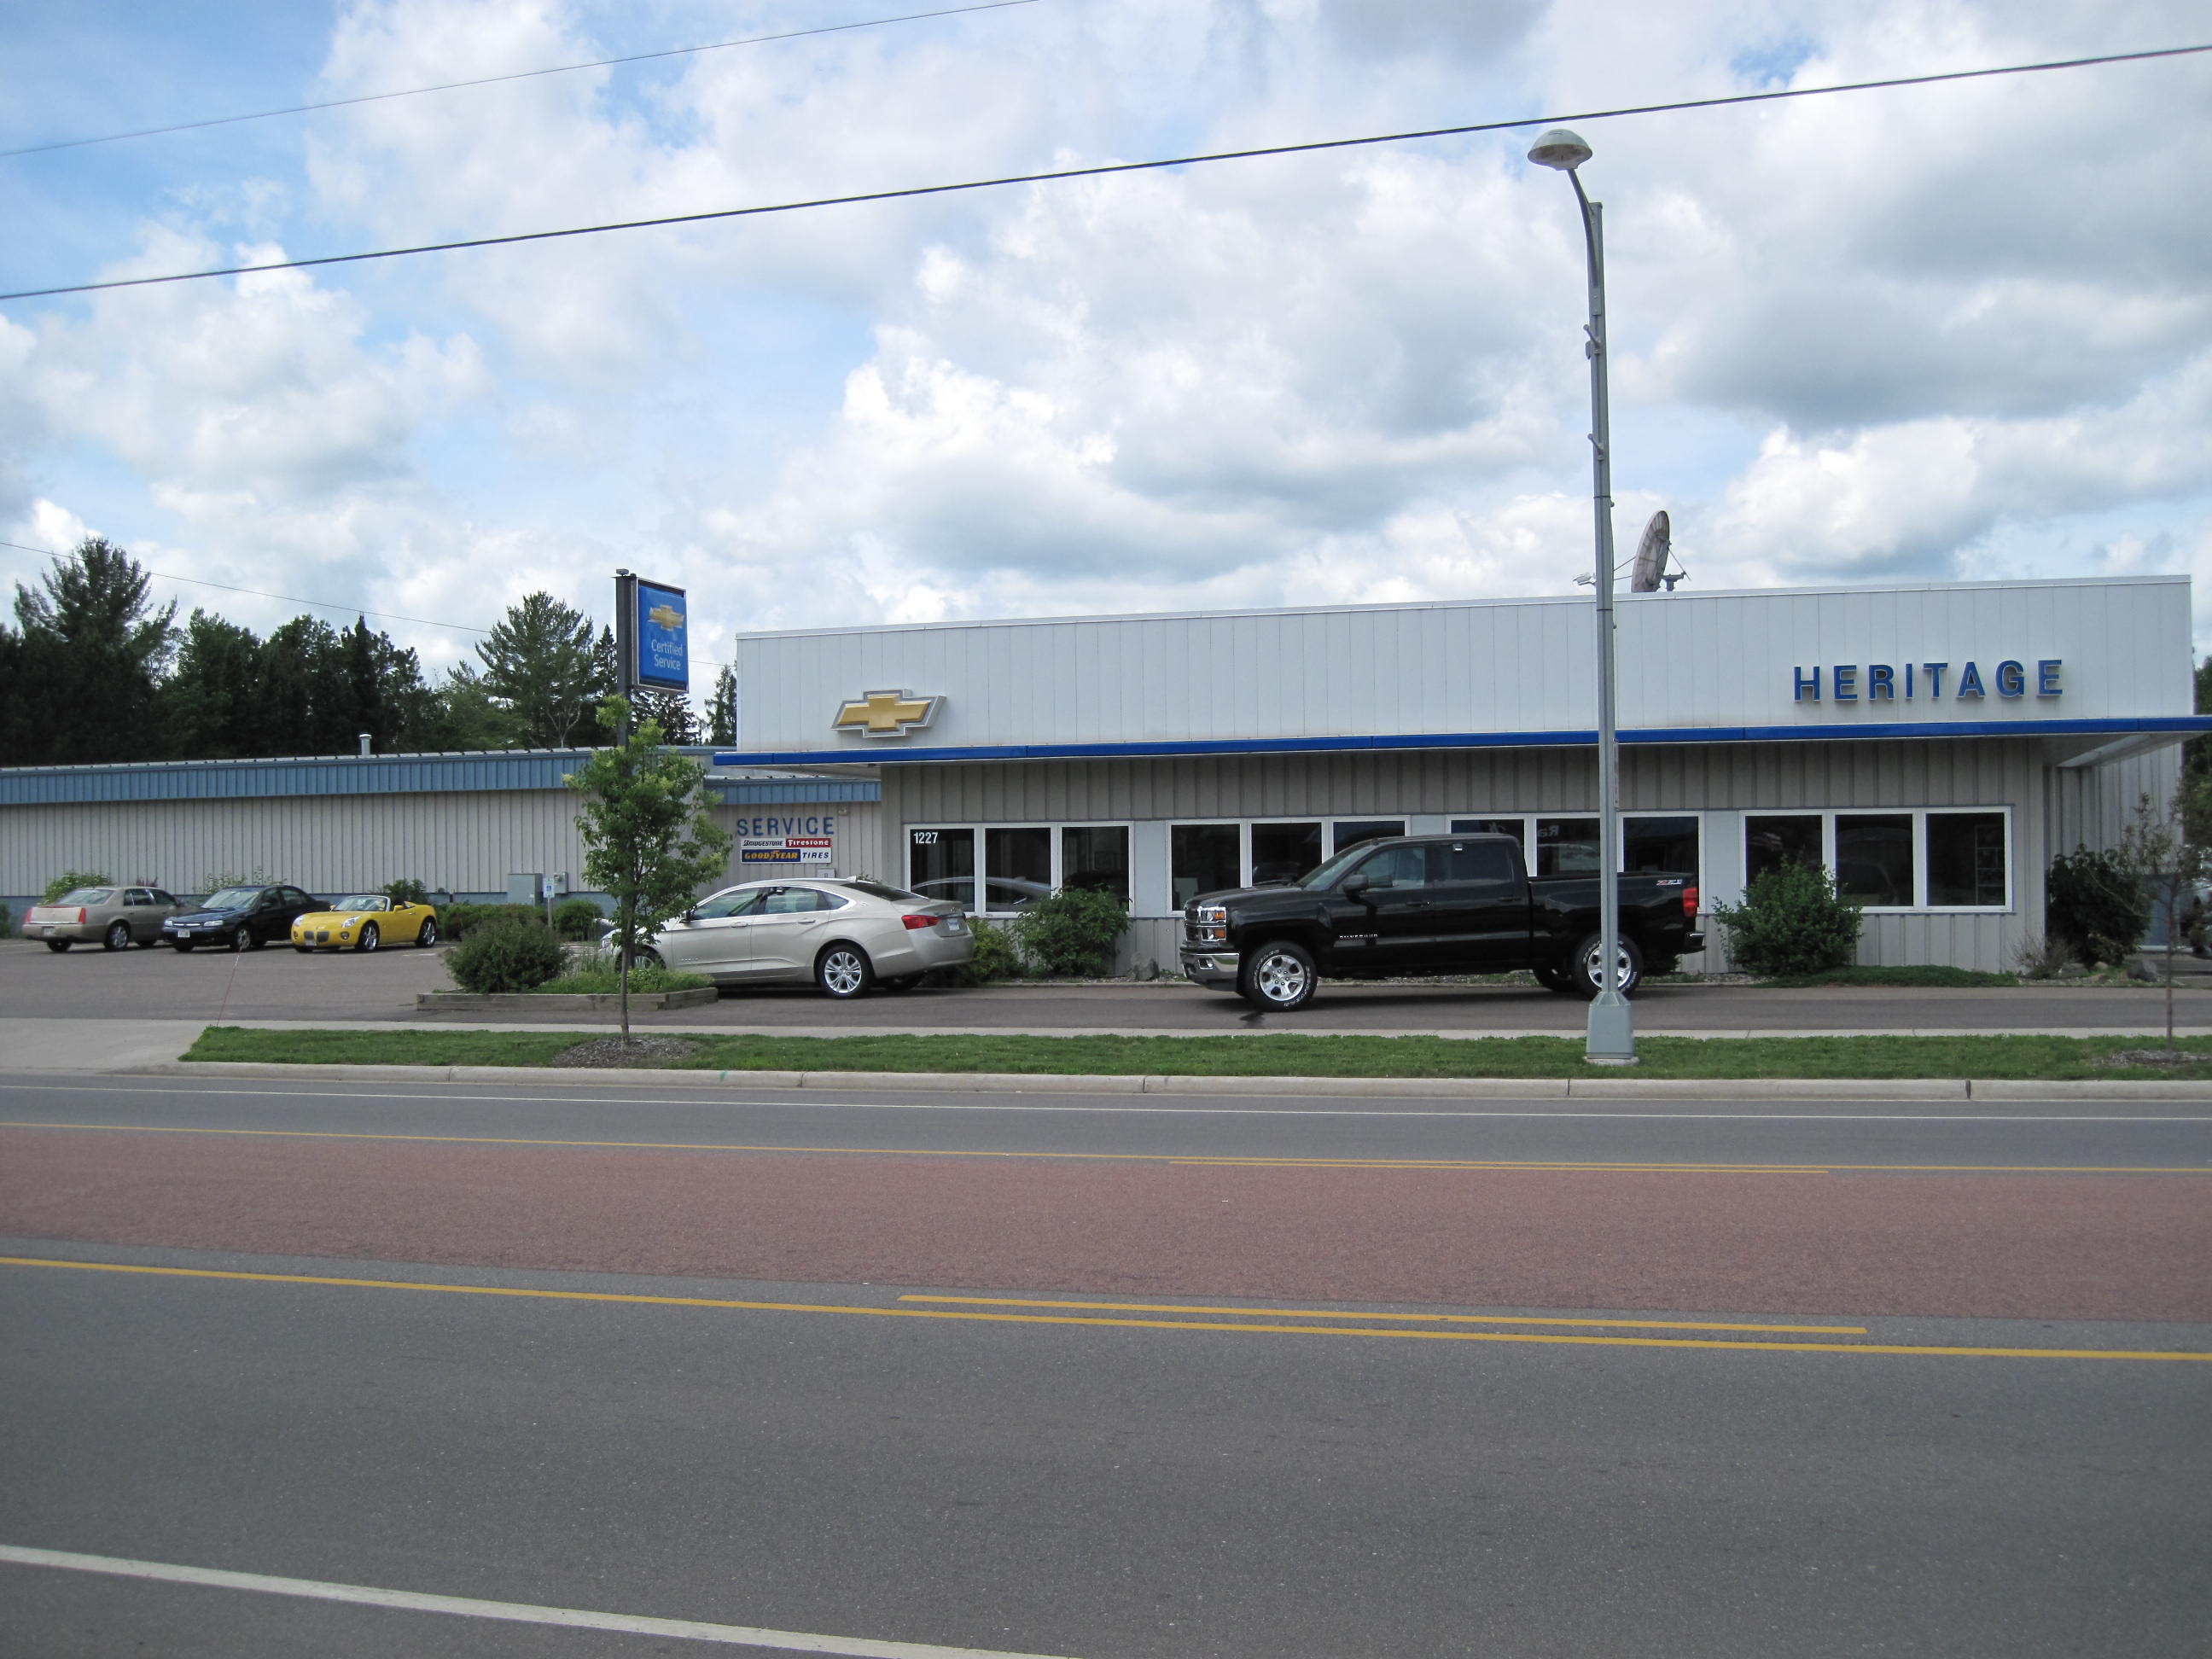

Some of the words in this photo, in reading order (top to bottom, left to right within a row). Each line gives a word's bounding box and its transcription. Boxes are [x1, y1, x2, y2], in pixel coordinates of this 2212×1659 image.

[651, 639, 683, 655] Certified
[654, 654, 681, 671] Service
[1793, 659, 2064, 702] HERITAGE
[736, 817, 834, 836] SERVICE
[913, 832, 939, 844] 1227
[744, 849, 798, 861] GOODYEAR
